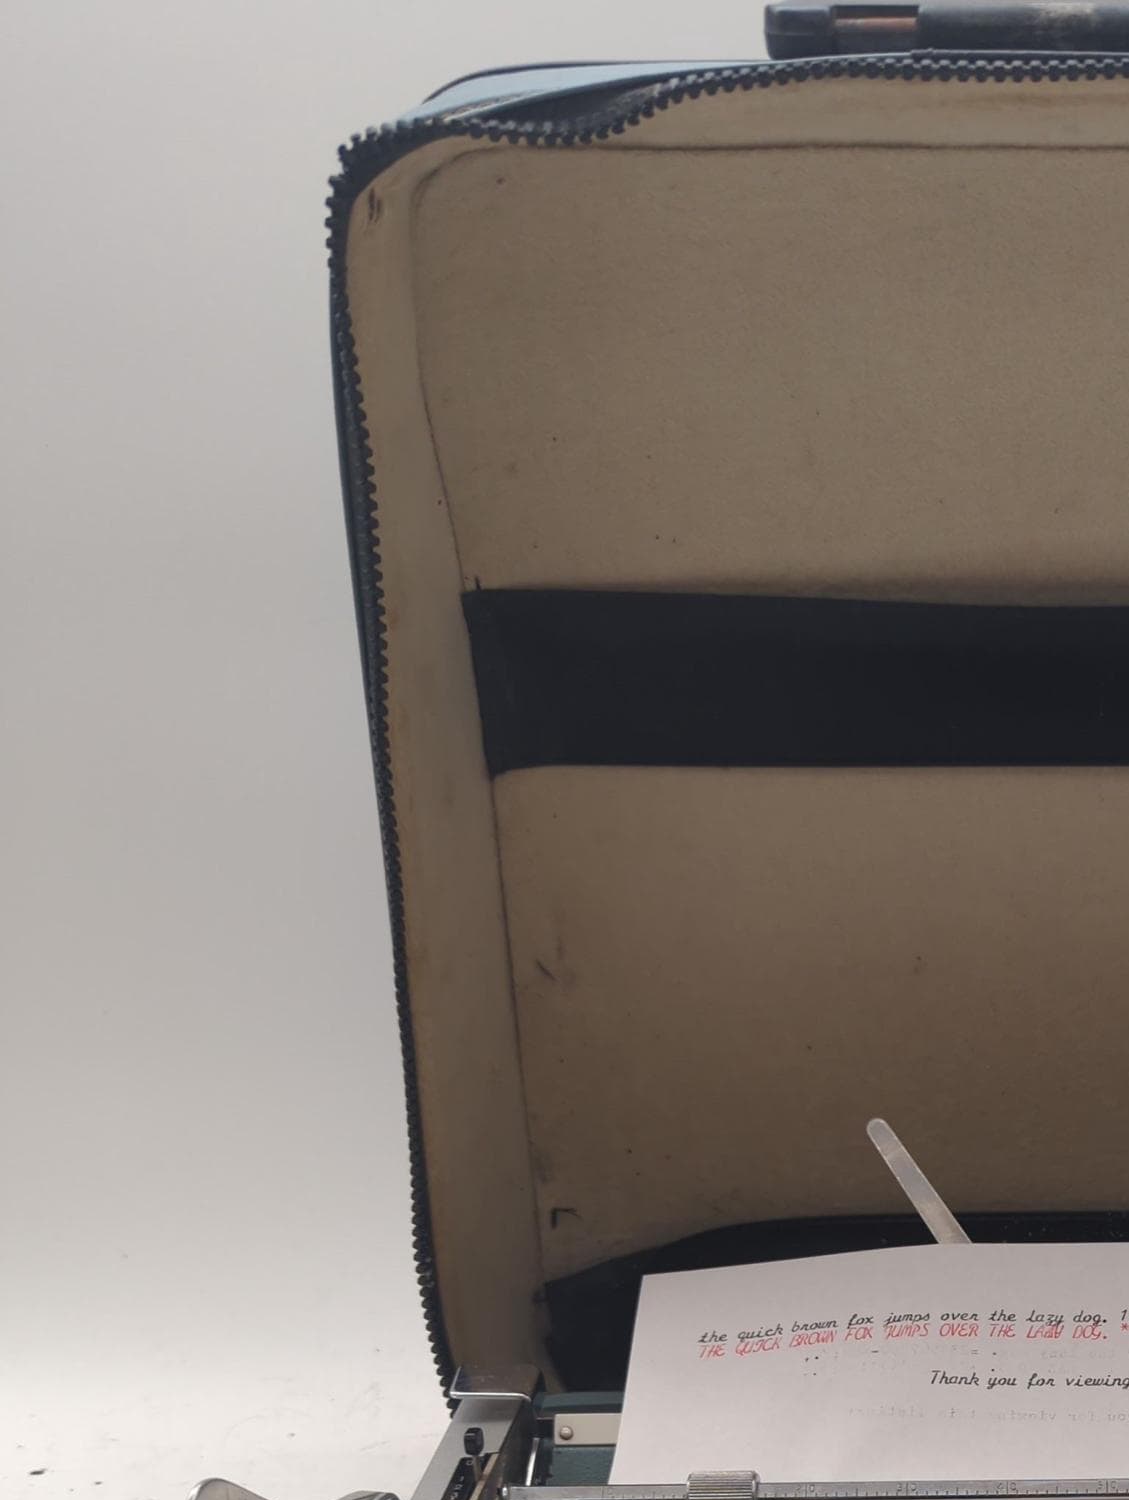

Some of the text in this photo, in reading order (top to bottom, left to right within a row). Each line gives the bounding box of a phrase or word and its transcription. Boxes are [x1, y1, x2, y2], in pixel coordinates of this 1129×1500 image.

[697, 1329, 728, 1344] the
[737, 1323, 783, 1342] quick
[791, 1319, 838, 1333] brown
[847, 1313, 874, 1329] fox
[884, 1311, 931, 1327] jumps
[940, 1312, 979, 1323] over
[989, 1309, 1017, 1323] the
[1026, 1310, 1064, 1327] lazy
[1072, 1310, 1107, 1327] dog.
[699, 1345, 727, 1360] THE
[734, 1336, 780, 1357] QUICK
[789, 1330, 838, 1348] BROWN
[844, 1325, 873, 1341] FOX
[884, 1323, 931, 1339] JUMPS
[939, 1322, 980, 1338] OVER
[989, 1323, 1017, 1338] THE
[1071, 1324, 1108, 1341] DOG.
[930, 1369, 980, 1387] Thank
[986, 1375, 1018, 1390] you
[1027, 1372, 1056, 1390] for
